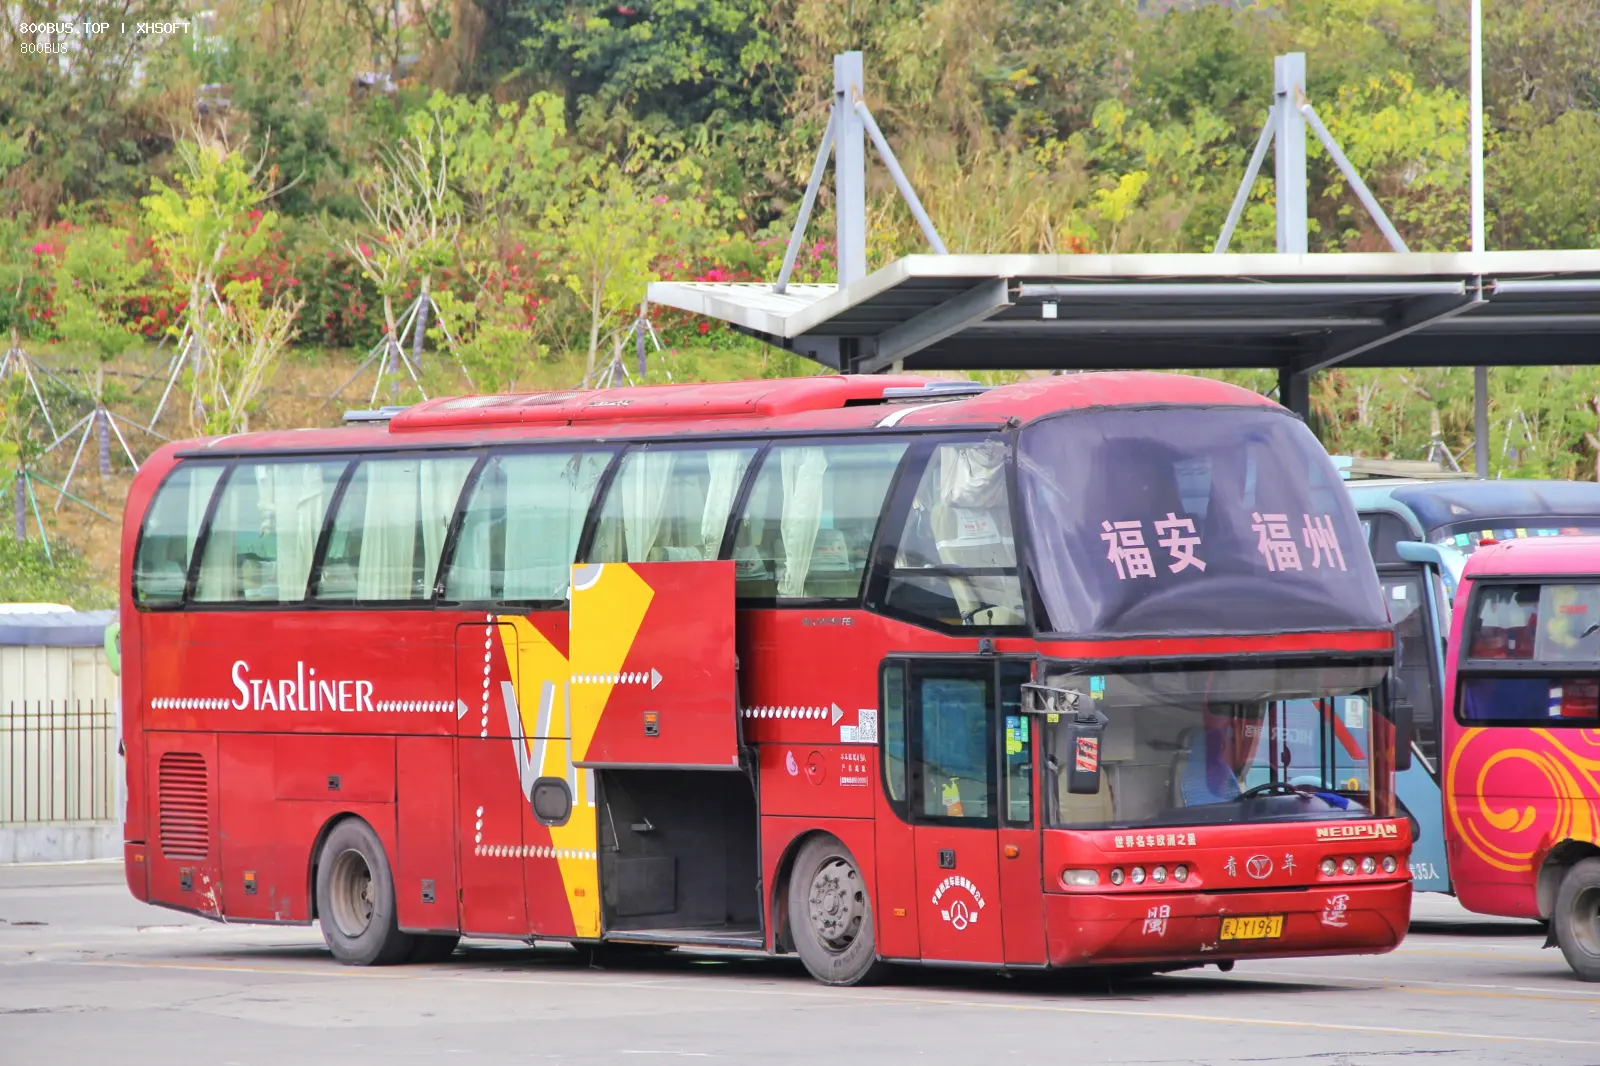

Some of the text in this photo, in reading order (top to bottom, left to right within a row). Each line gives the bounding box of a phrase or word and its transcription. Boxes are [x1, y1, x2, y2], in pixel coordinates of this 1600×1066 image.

[1100, 511, 1348, 580] 福安 福州
[1114, 832, 1197, 849] 世界名车欧洲之星
[1316, 823, 1398, 842] NEOPLAN
[1223, 855, 1238, 878] 青
